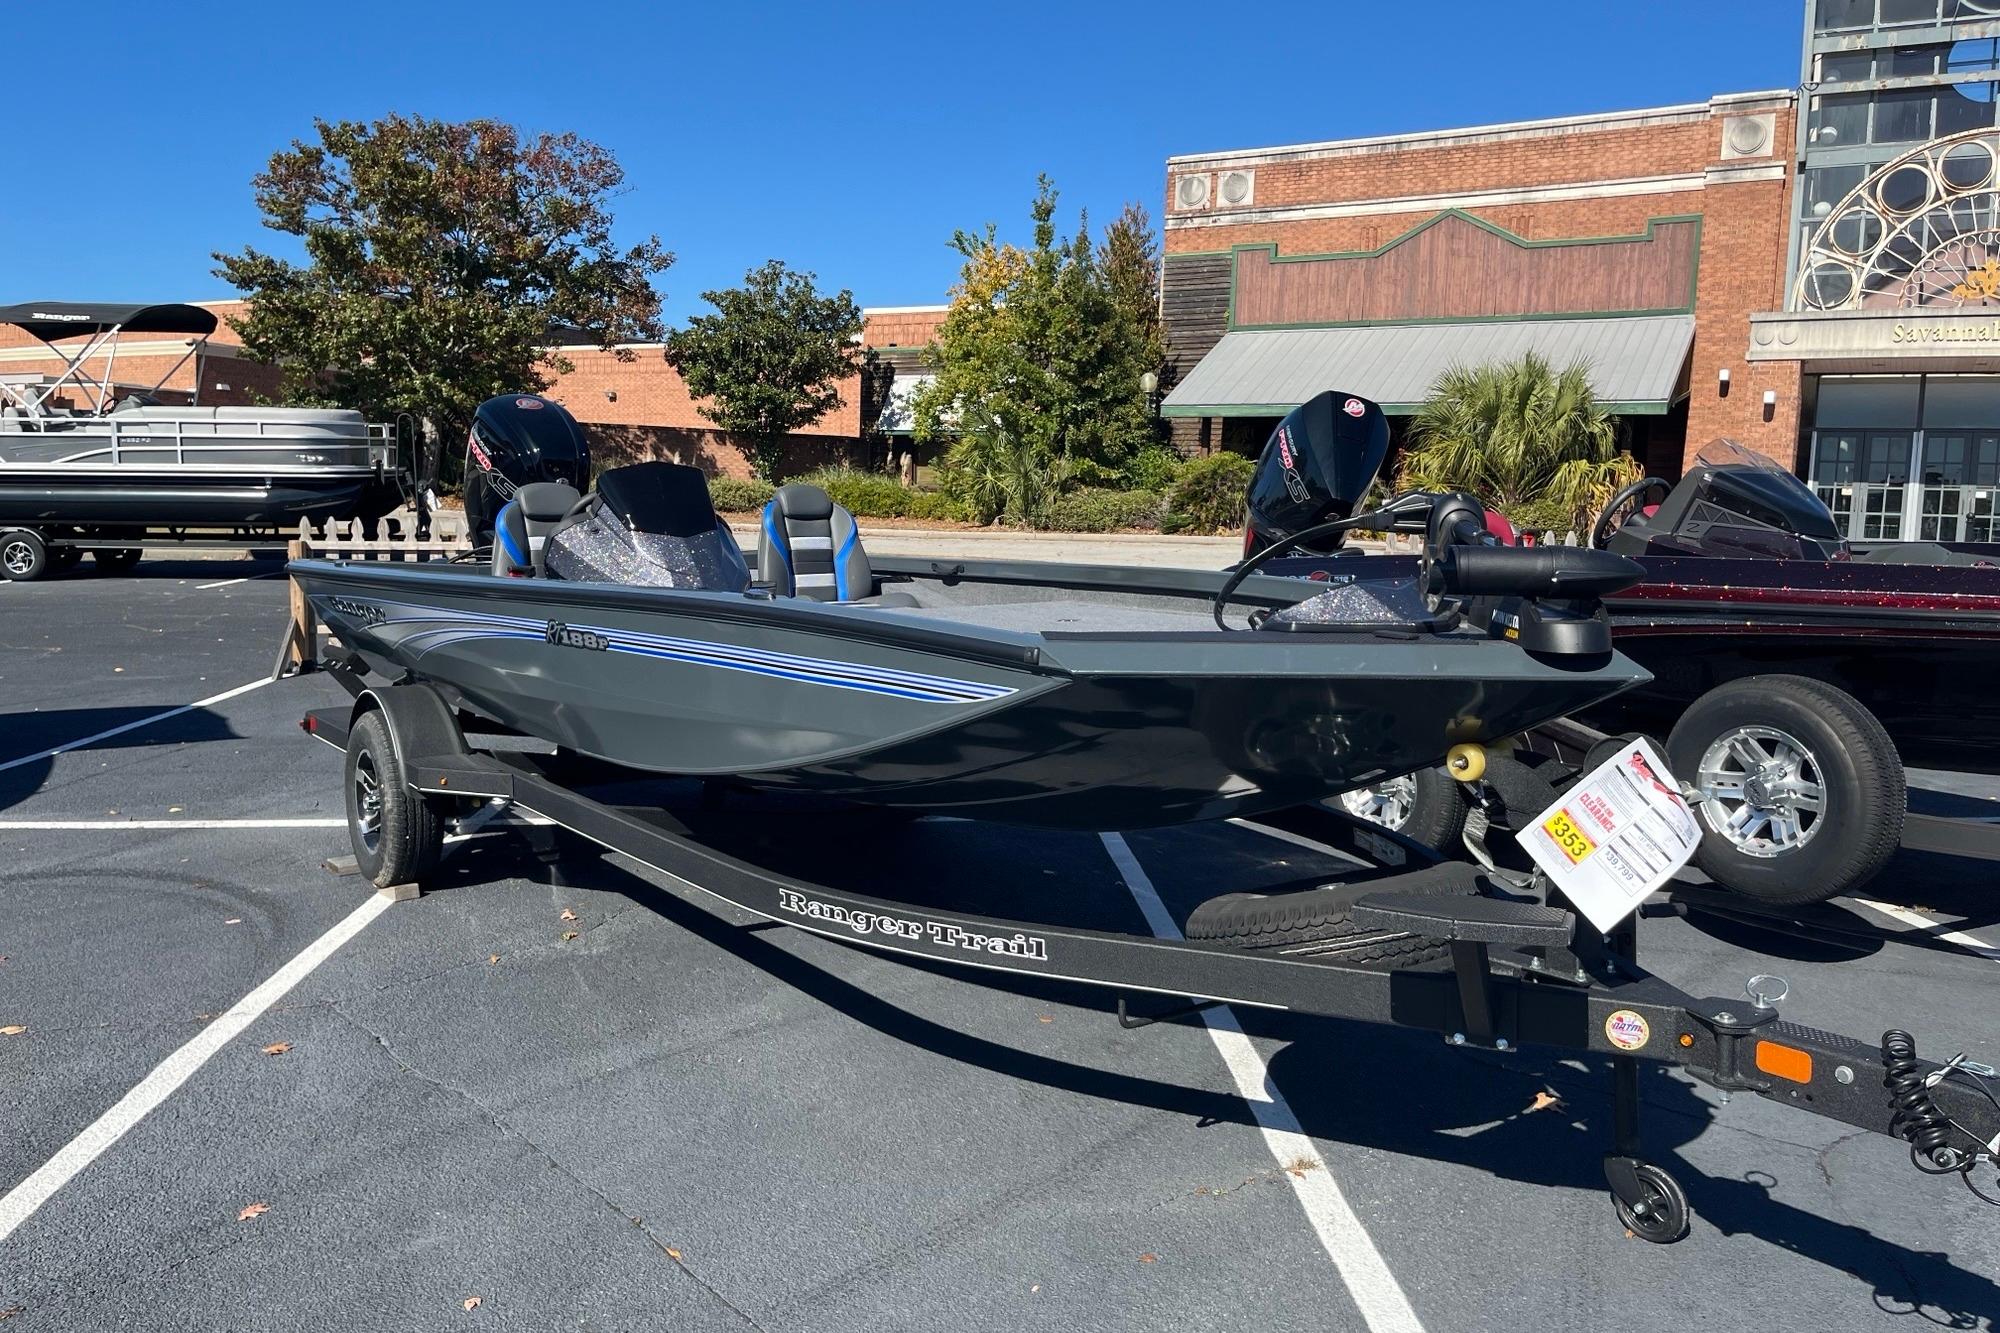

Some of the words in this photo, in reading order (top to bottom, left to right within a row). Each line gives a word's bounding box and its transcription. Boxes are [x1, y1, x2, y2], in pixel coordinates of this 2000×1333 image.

[32, 312, 91, 322] Ranger
[1277, 457, 1311, 504] XS
[1579, 792, 1617, 834] CLEARANCE
[1553, 816, 1588, 857] $353
[778, 888, 923, 940] Ranger
[927, 921, 1048, 961] Trail
